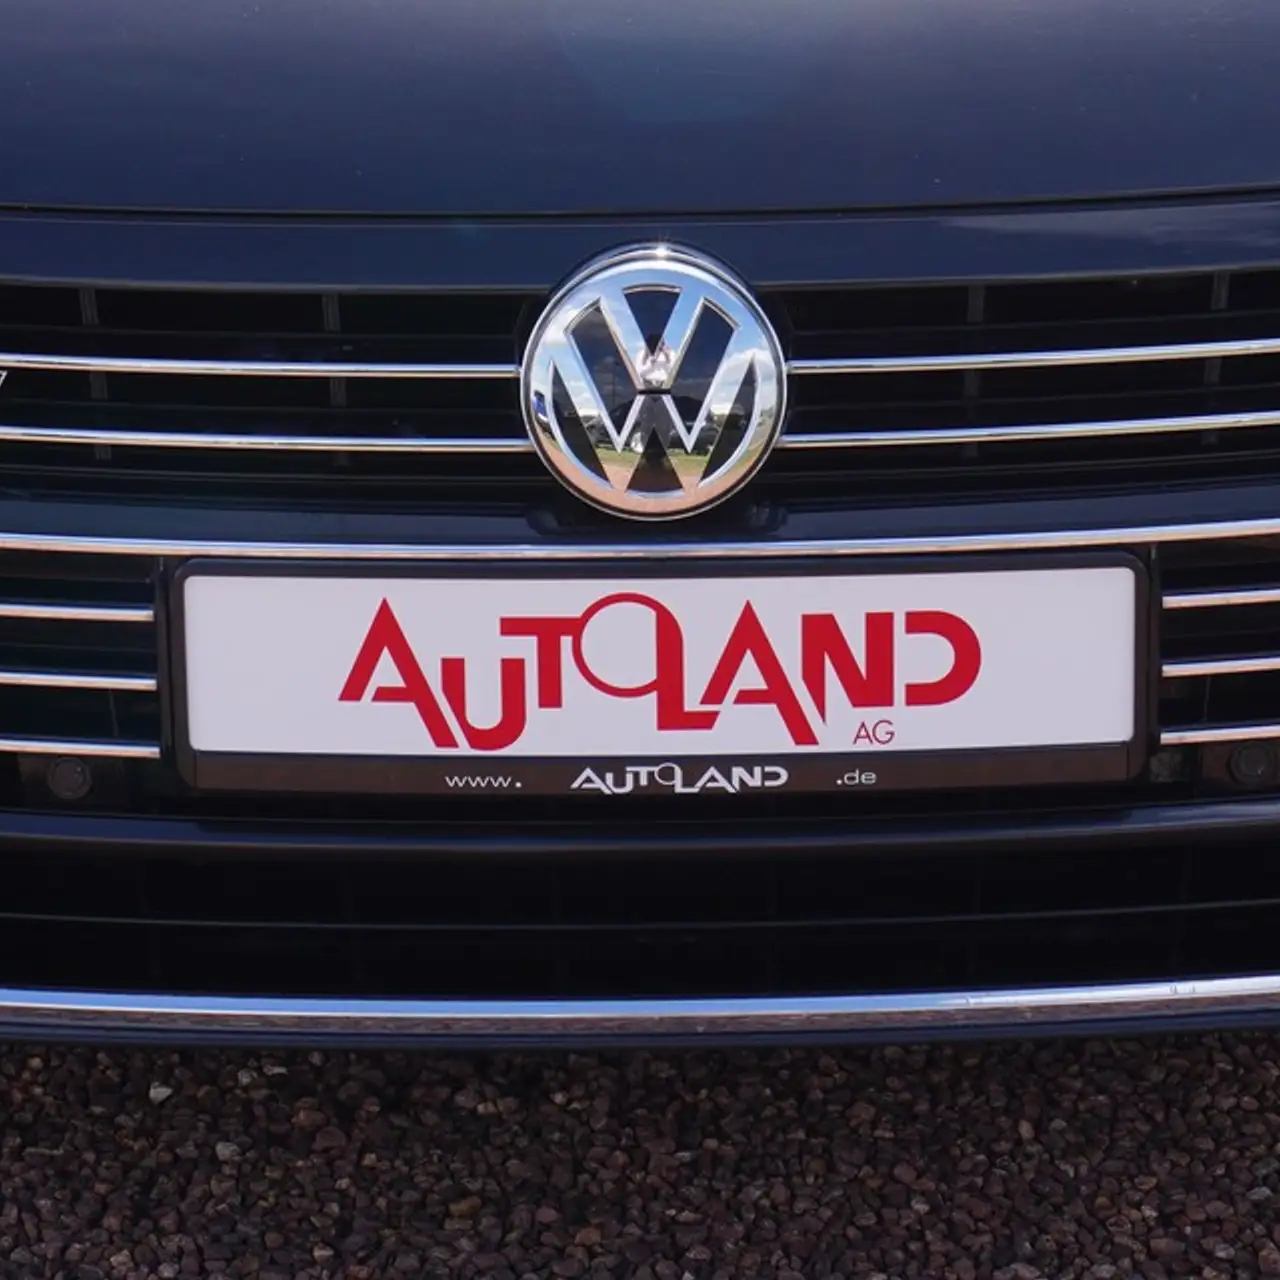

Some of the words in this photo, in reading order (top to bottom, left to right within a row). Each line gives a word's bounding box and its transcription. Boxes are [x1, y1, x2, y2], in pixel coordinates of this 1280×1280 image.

[338, 592, 982, 751] AUTOLAND
[852, 719, 896, 746] AG
[443, 773, 523, 789] www.
[569, 762, 790, 795] AUTOLAND
[835, 767, 878, 786] .de
